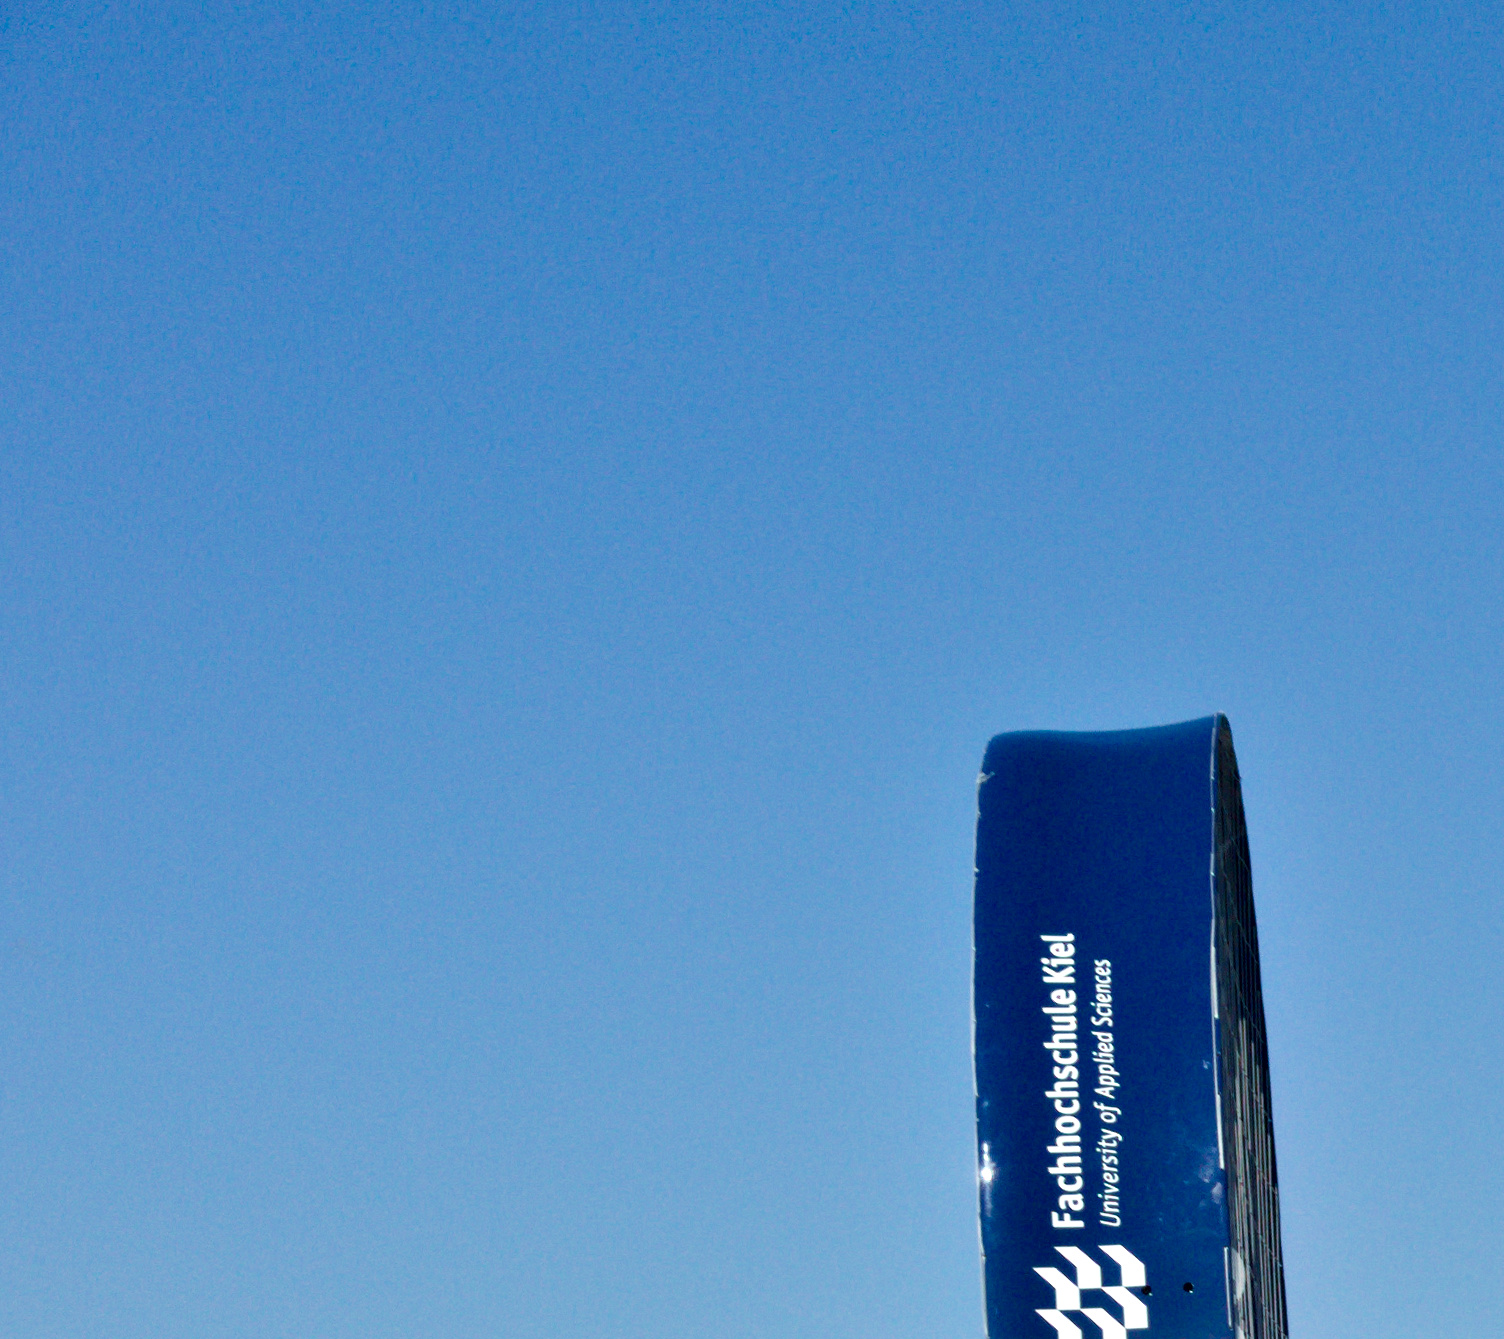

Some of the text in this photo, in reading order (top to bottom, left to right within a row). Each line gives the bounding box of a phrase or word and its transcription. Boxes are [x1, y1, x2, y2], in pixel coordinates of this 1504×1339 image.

[1040, 932, 1085, 1230] Fachhochschule Kiel
[1089, 959, 1123, 1227] University of Applied Sciences
